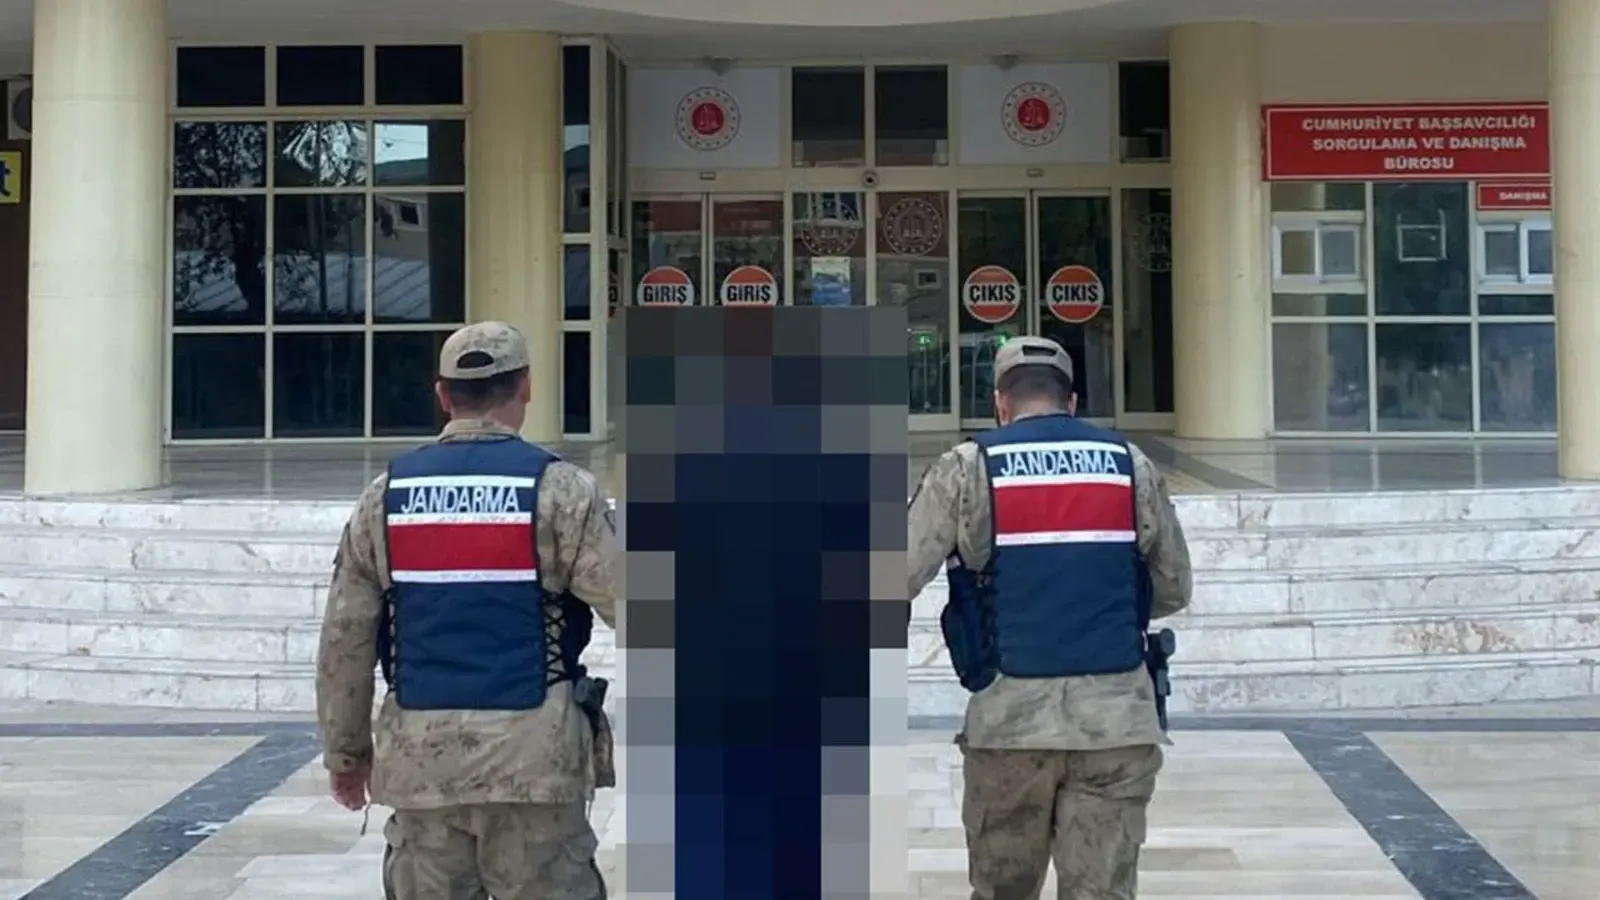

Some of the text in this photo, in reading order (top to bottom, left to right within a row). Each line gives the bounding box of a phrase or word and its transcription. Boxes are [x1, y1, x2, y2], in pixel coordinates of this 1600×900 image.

[1302, 114, 1536, 132] CUMHURİYET BAŞSAVCILIĞI
[1312, 136, 1526, 152] SORGULAMA VE DANIŞMA
[1384, 155, 1455, 170] BÜROSU
[1000, 450, 1119, 476] JANDARMA
[401, 486, 519, 513] JANDARMA
